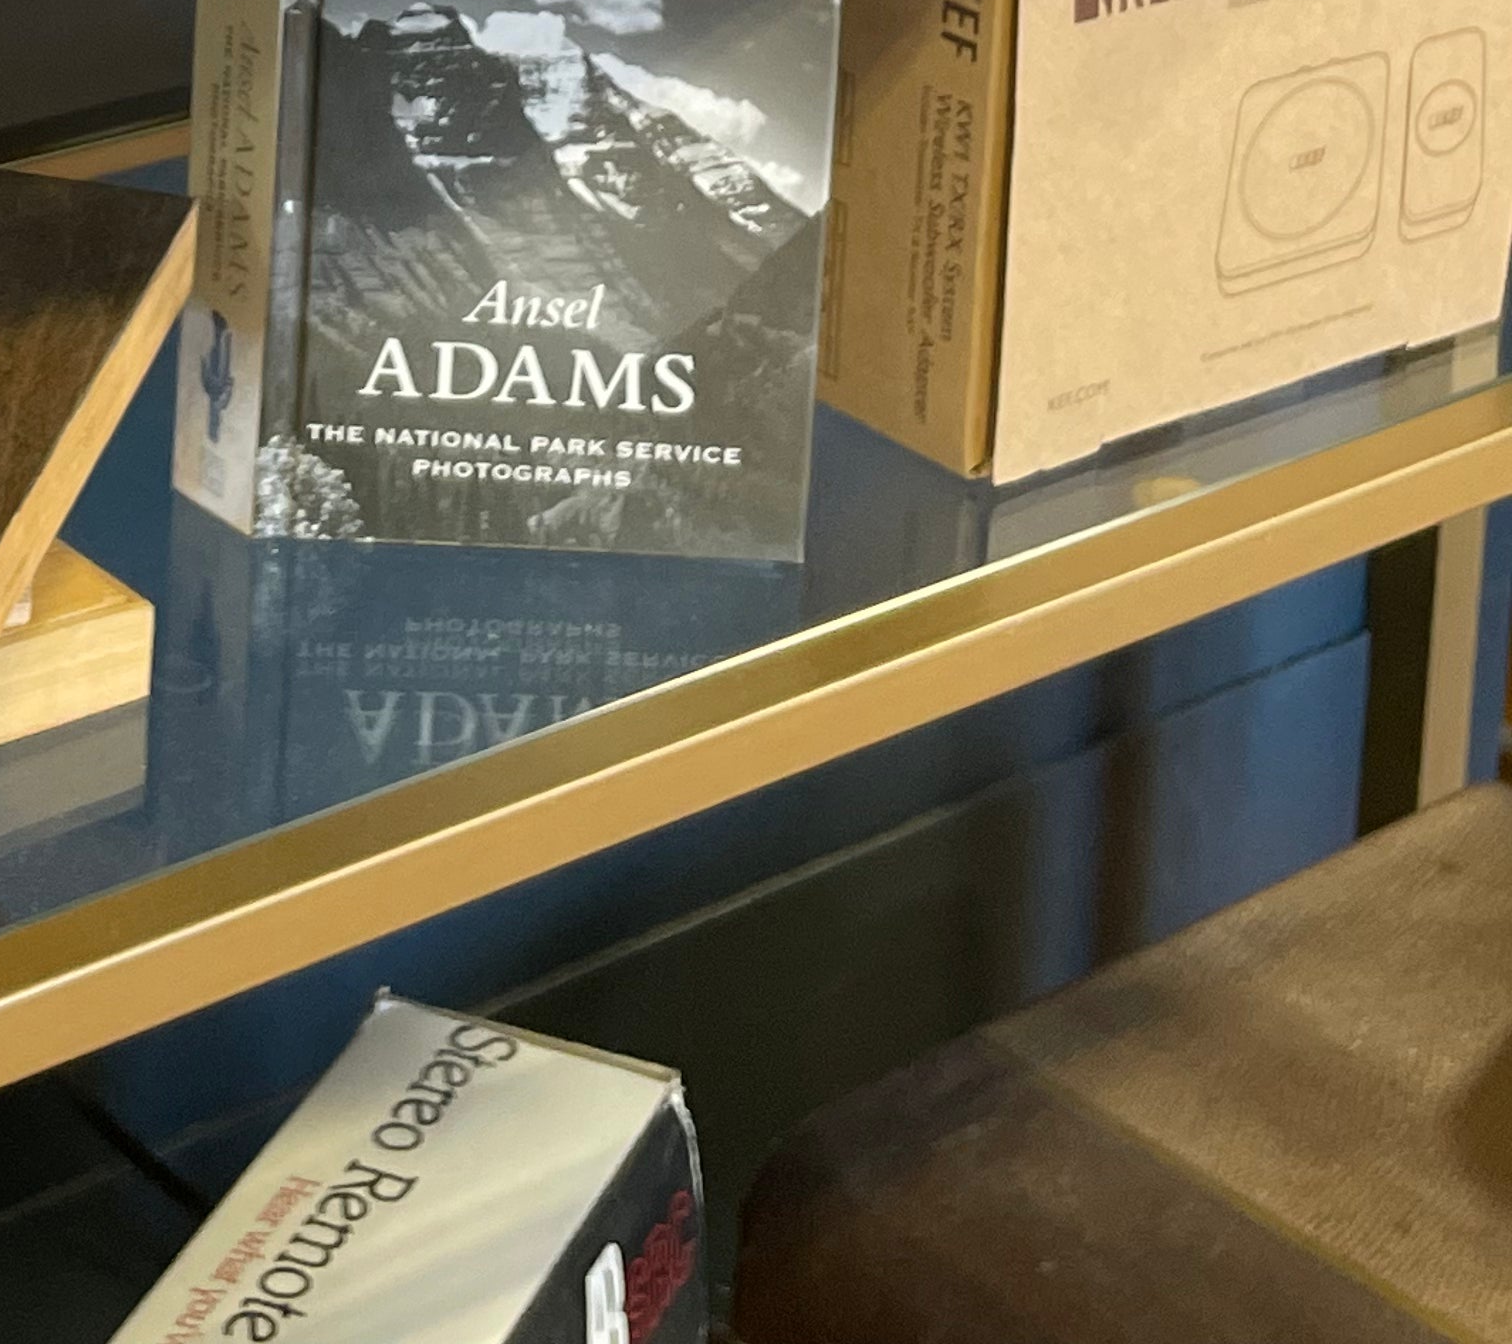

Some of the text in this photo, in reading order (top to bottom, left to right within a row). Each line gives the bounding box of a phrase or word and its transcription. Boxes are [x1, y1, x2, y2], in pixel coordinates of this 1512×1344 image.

[461, 279, 607, 331] Ansel
[358, 337, 698, 415] ADAMS
[305, 422, 743, 467] THE NATIONAL PARK SERVICE
[411, 458, 633, 489] PHOTOGRAPHS
[220, 1021, 521, 1343] Stereo Remote
[255, 1174, 321, 1228] Hear
[210, 1231, 273, 1285] what
